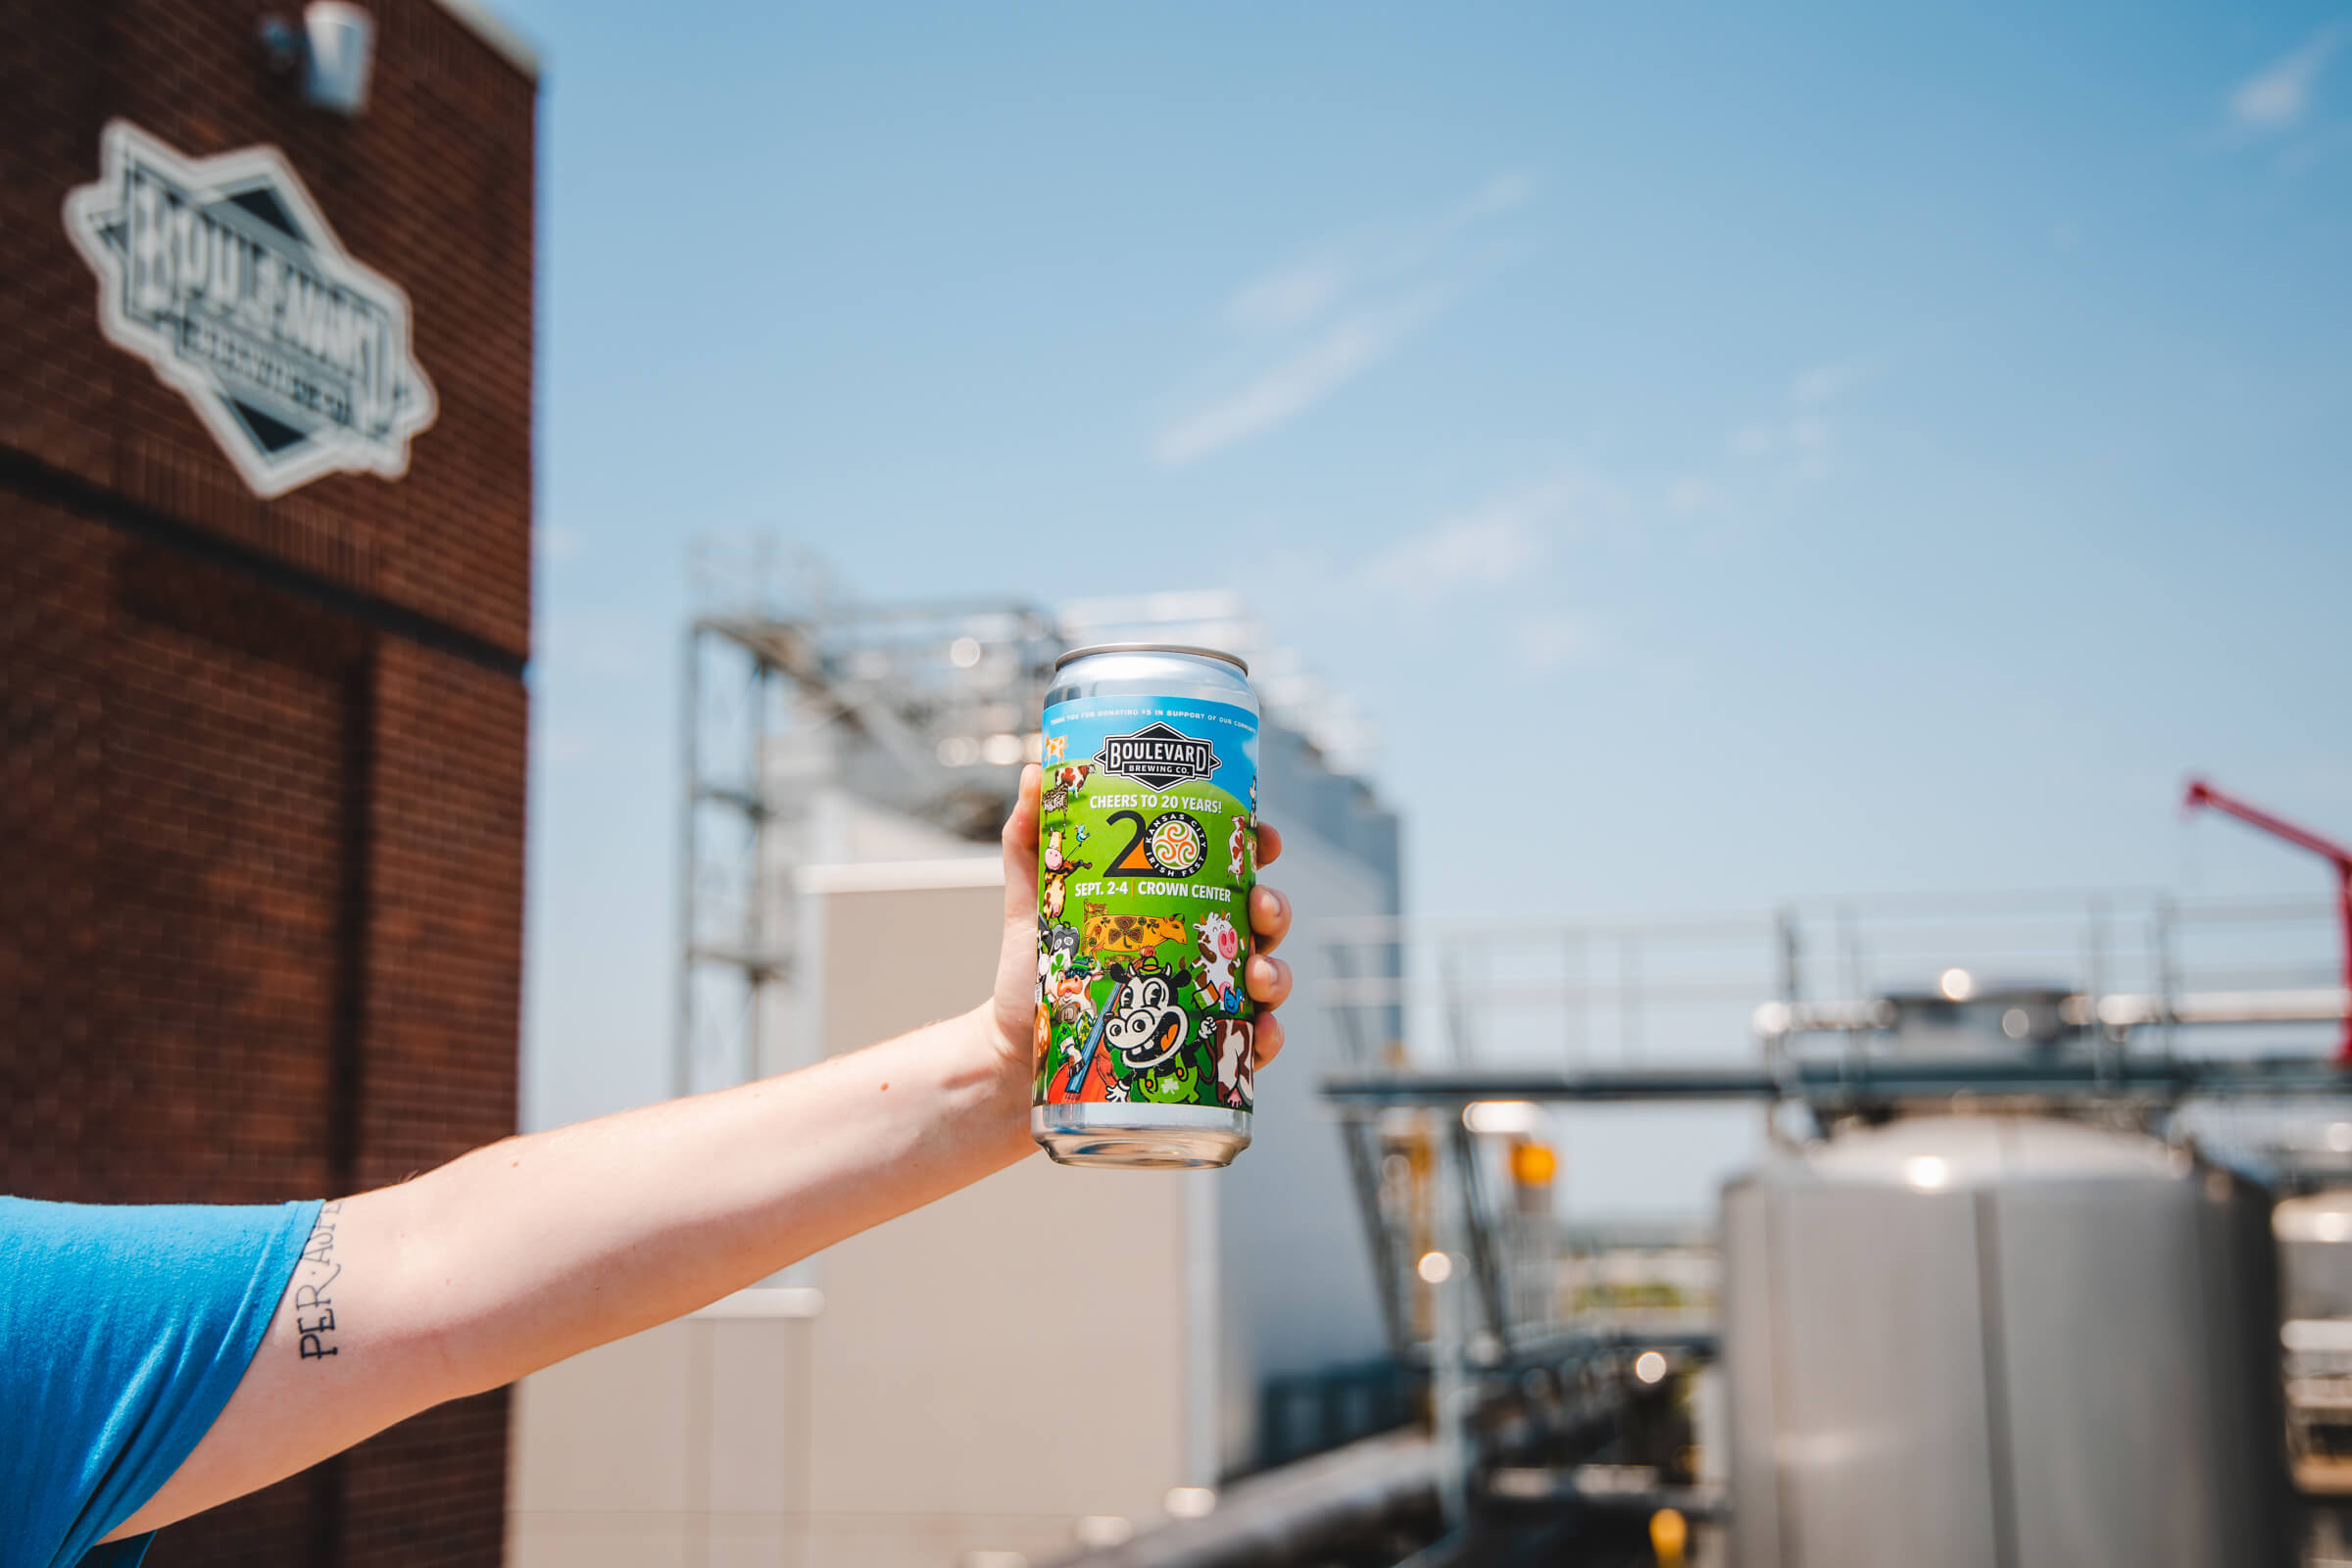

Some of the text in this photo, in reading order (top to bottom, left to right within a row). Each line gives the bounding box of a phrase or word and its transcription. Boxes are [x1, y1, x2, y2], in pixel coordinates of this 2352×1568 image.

[1166, 710, 1204, 719] SUPPORT
[1109, 742, 1206, 772] BOULEVARD
[1128, 764, 1190, 775] BREWING CO.
[1090, 795, 1222, 813] CHEERS TO 20 YEARS!
[1145, 813, 1206, 848] KANSAS CITY
[1146, 852, 1204, 877] IRISH FEST
[1074, 881, 1232, 903] SEPT. 2-4 CROWN CENTER
[296, 1263, 342, 1359] PER
